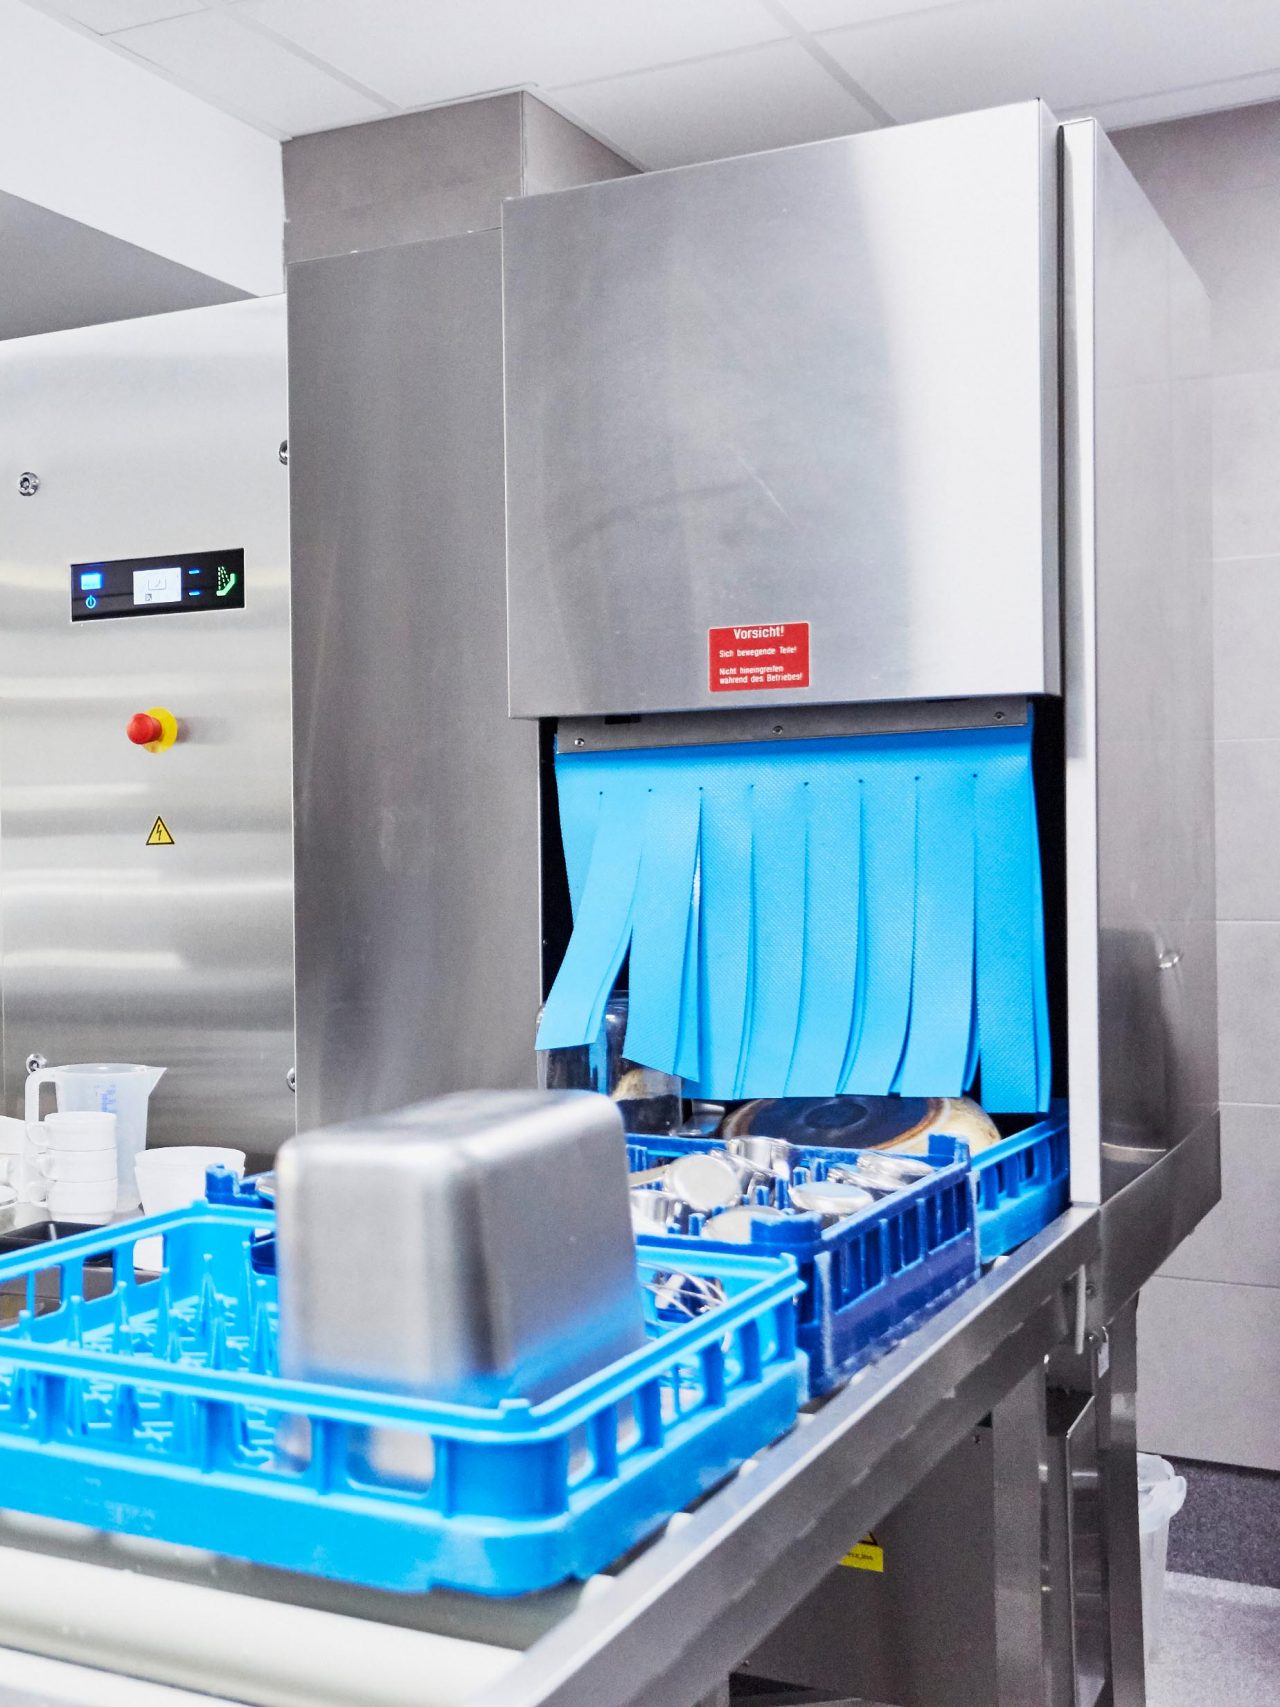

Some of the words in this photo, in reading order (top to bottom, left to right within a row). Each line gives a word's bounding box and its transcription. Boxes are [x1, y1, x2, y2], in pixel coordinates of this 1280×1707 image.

[733, 626, 784, 639] Vorsicht!
[719, 650, 734, 658] Sich
[736, 648, 776, 657] bewegende
[719, 667, 737, 675] Nicht
[739, 665, 784, 674] hineingreifen
[750, 675, 764, 683] des
